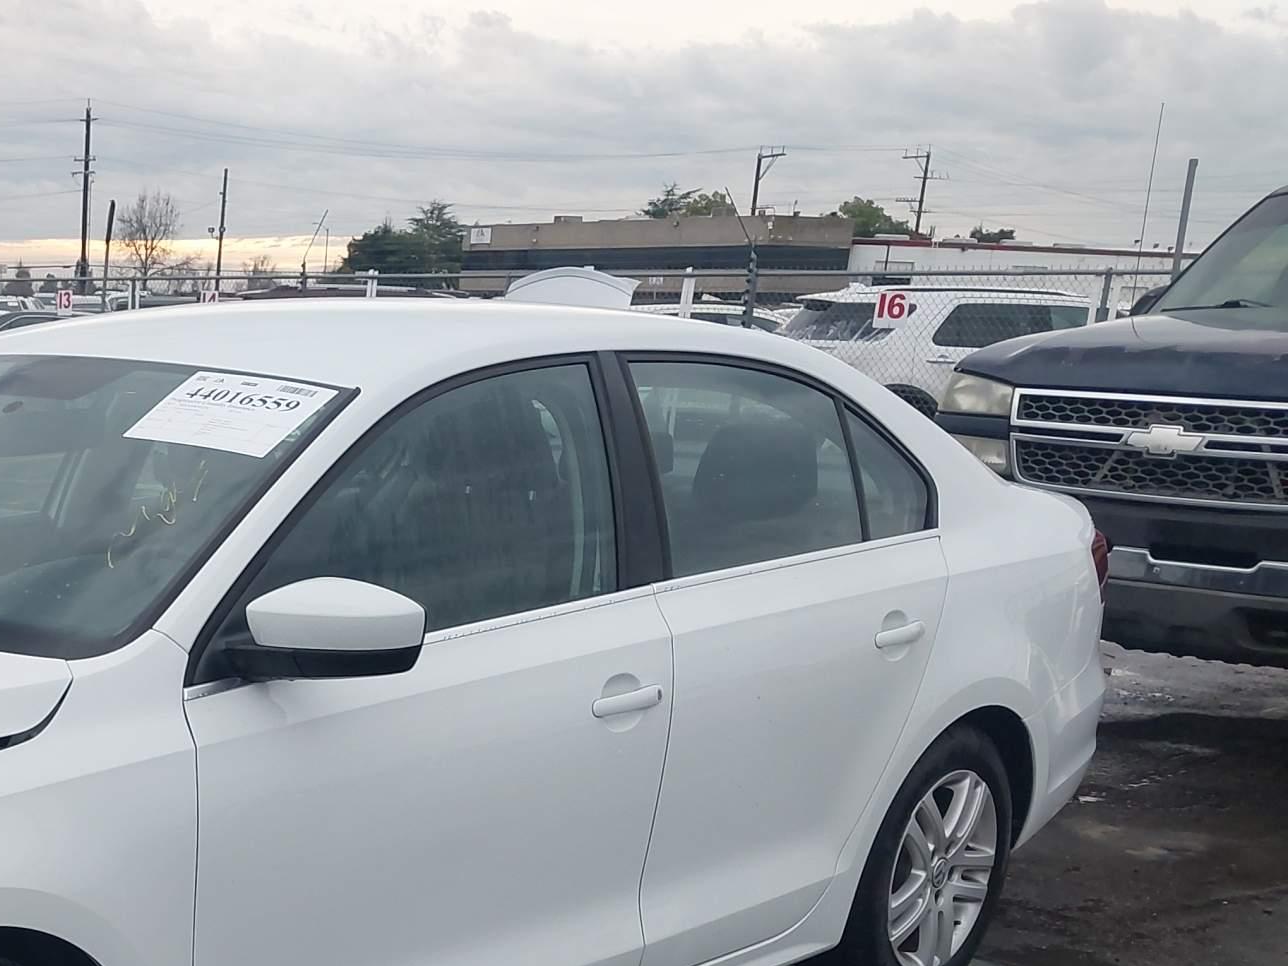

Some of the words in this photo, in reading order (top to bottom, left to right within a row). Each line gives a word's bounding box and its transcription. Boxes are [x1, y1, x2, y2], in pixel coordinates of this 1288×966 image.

[59, 291, 71, 309] 13
[877, 293, 906, 319] 16
[185, 386, 301, 412] 44016559
